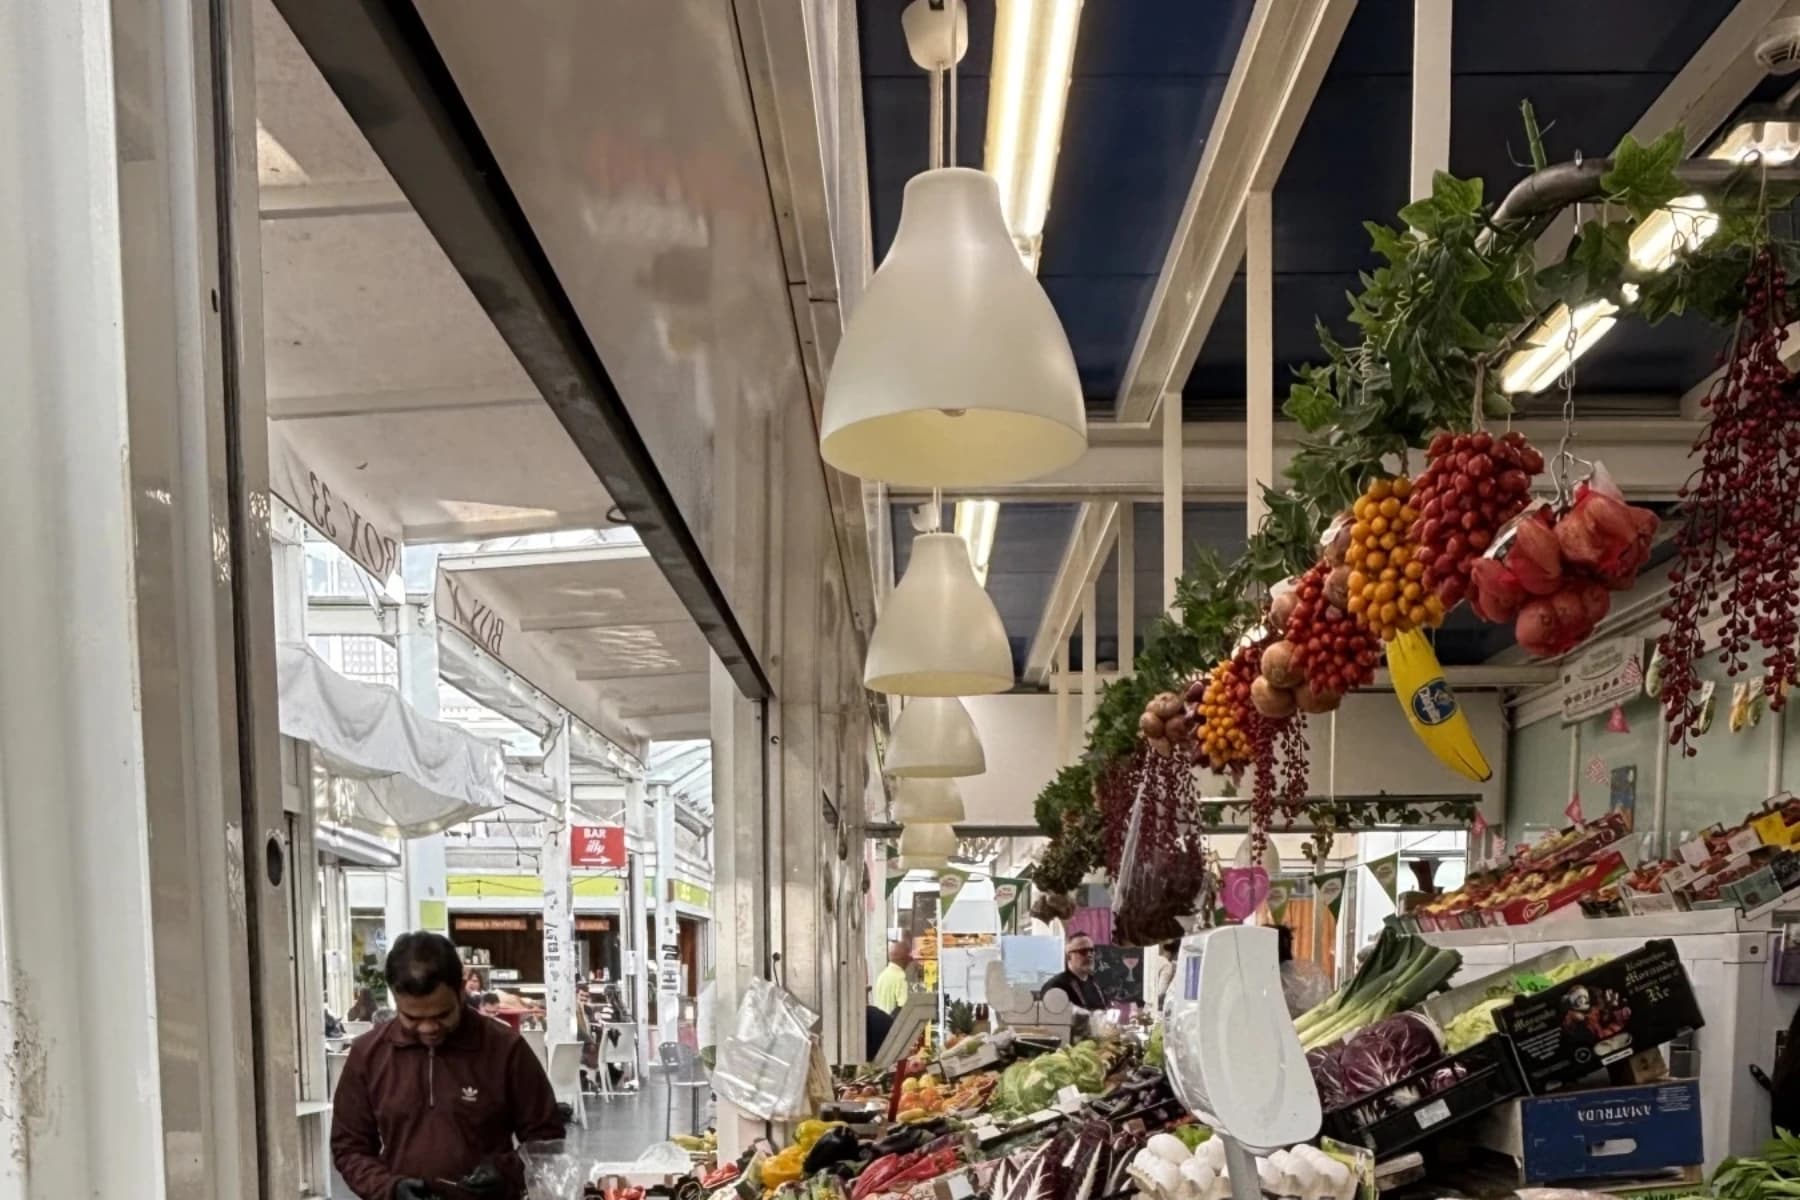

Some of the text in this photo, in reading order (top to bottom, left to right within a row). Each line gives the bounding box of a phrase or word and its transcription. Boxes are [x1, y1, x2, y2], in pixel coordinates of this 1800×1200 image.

[584, 828, 606, 839] BAR
[586, 840, 605, 853] illy
[1577, 1104, 1652, 1122] AMATRUDA
